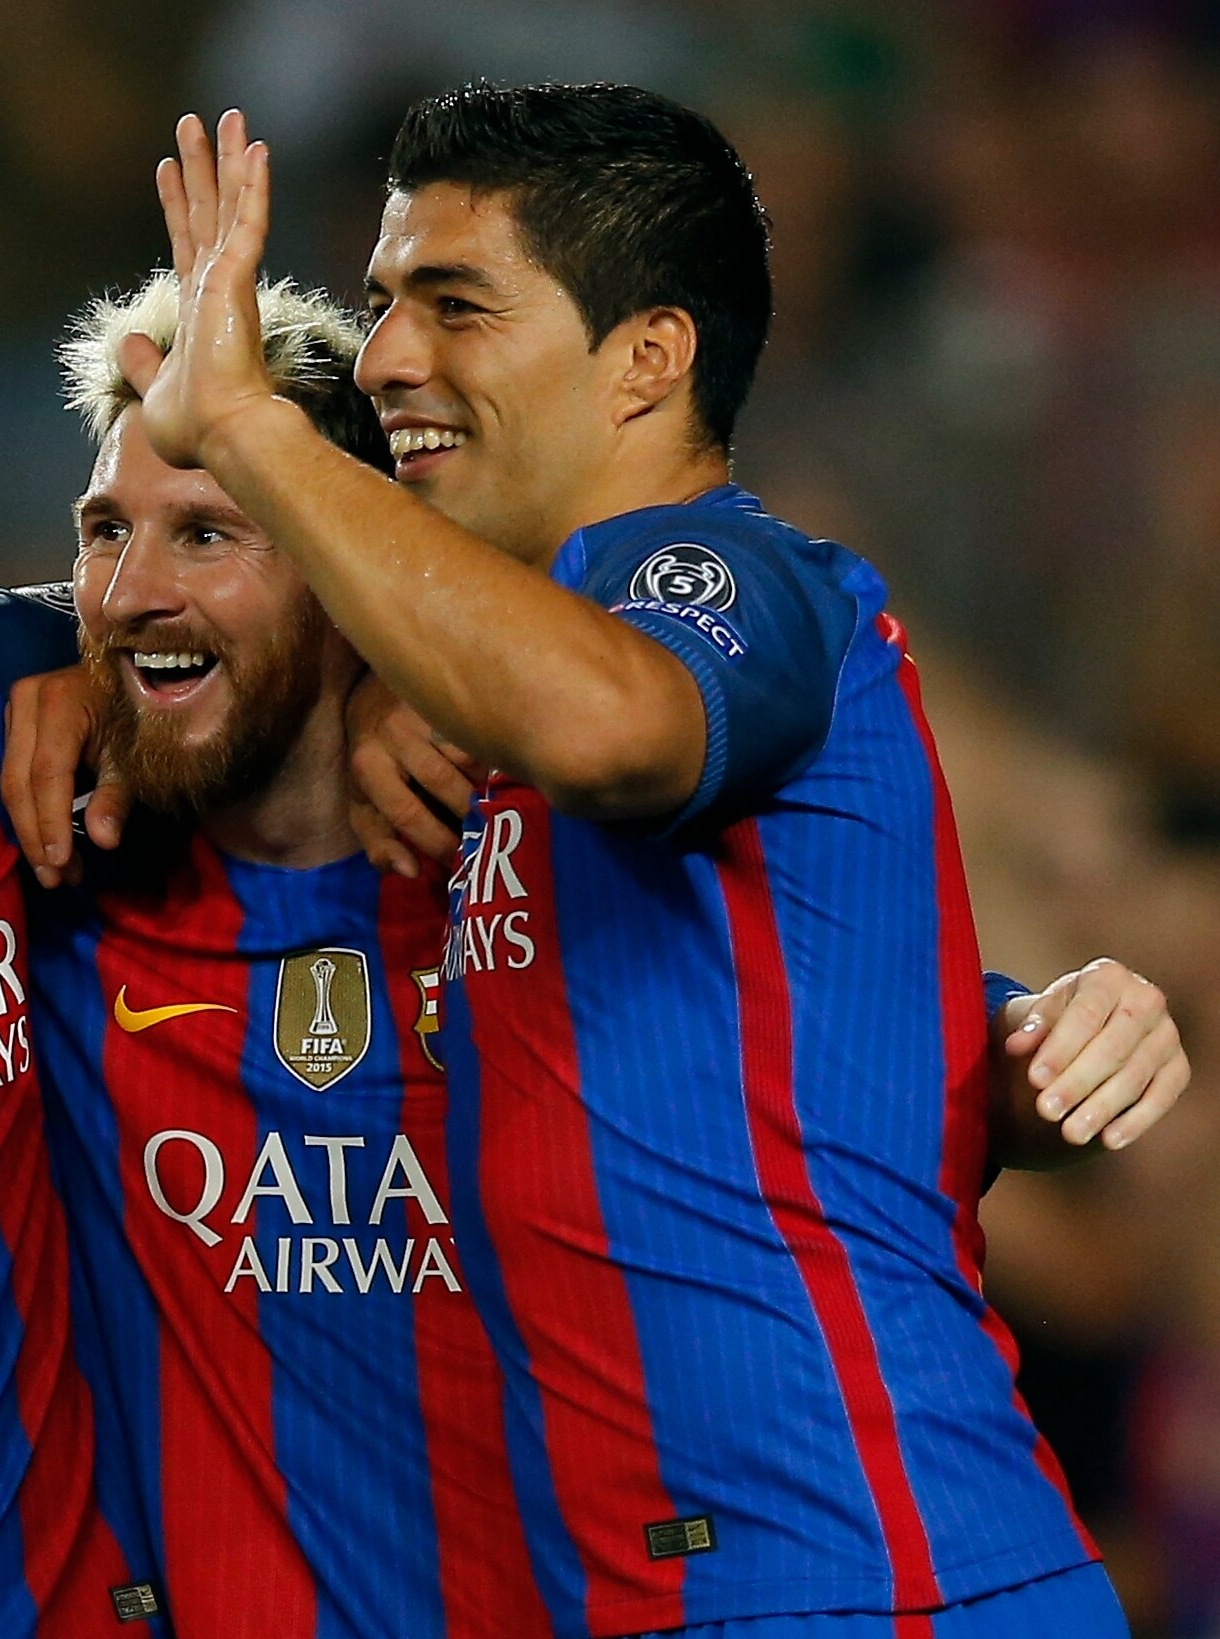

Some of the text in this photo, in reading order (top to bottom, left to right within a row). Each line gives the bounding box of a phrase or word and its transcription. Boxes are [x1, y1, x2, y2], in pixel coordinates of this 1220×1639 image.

[668, 575, 696, 595] 5
[625, 601, 744, 657] RESPECT
[301, 1037, 343, 1054] FIFA
[306, 1062, 333, 1073] 2015
[143, 1130, 450, 1247] QATA
[223, 1236, 463, 1293] AIRWA
